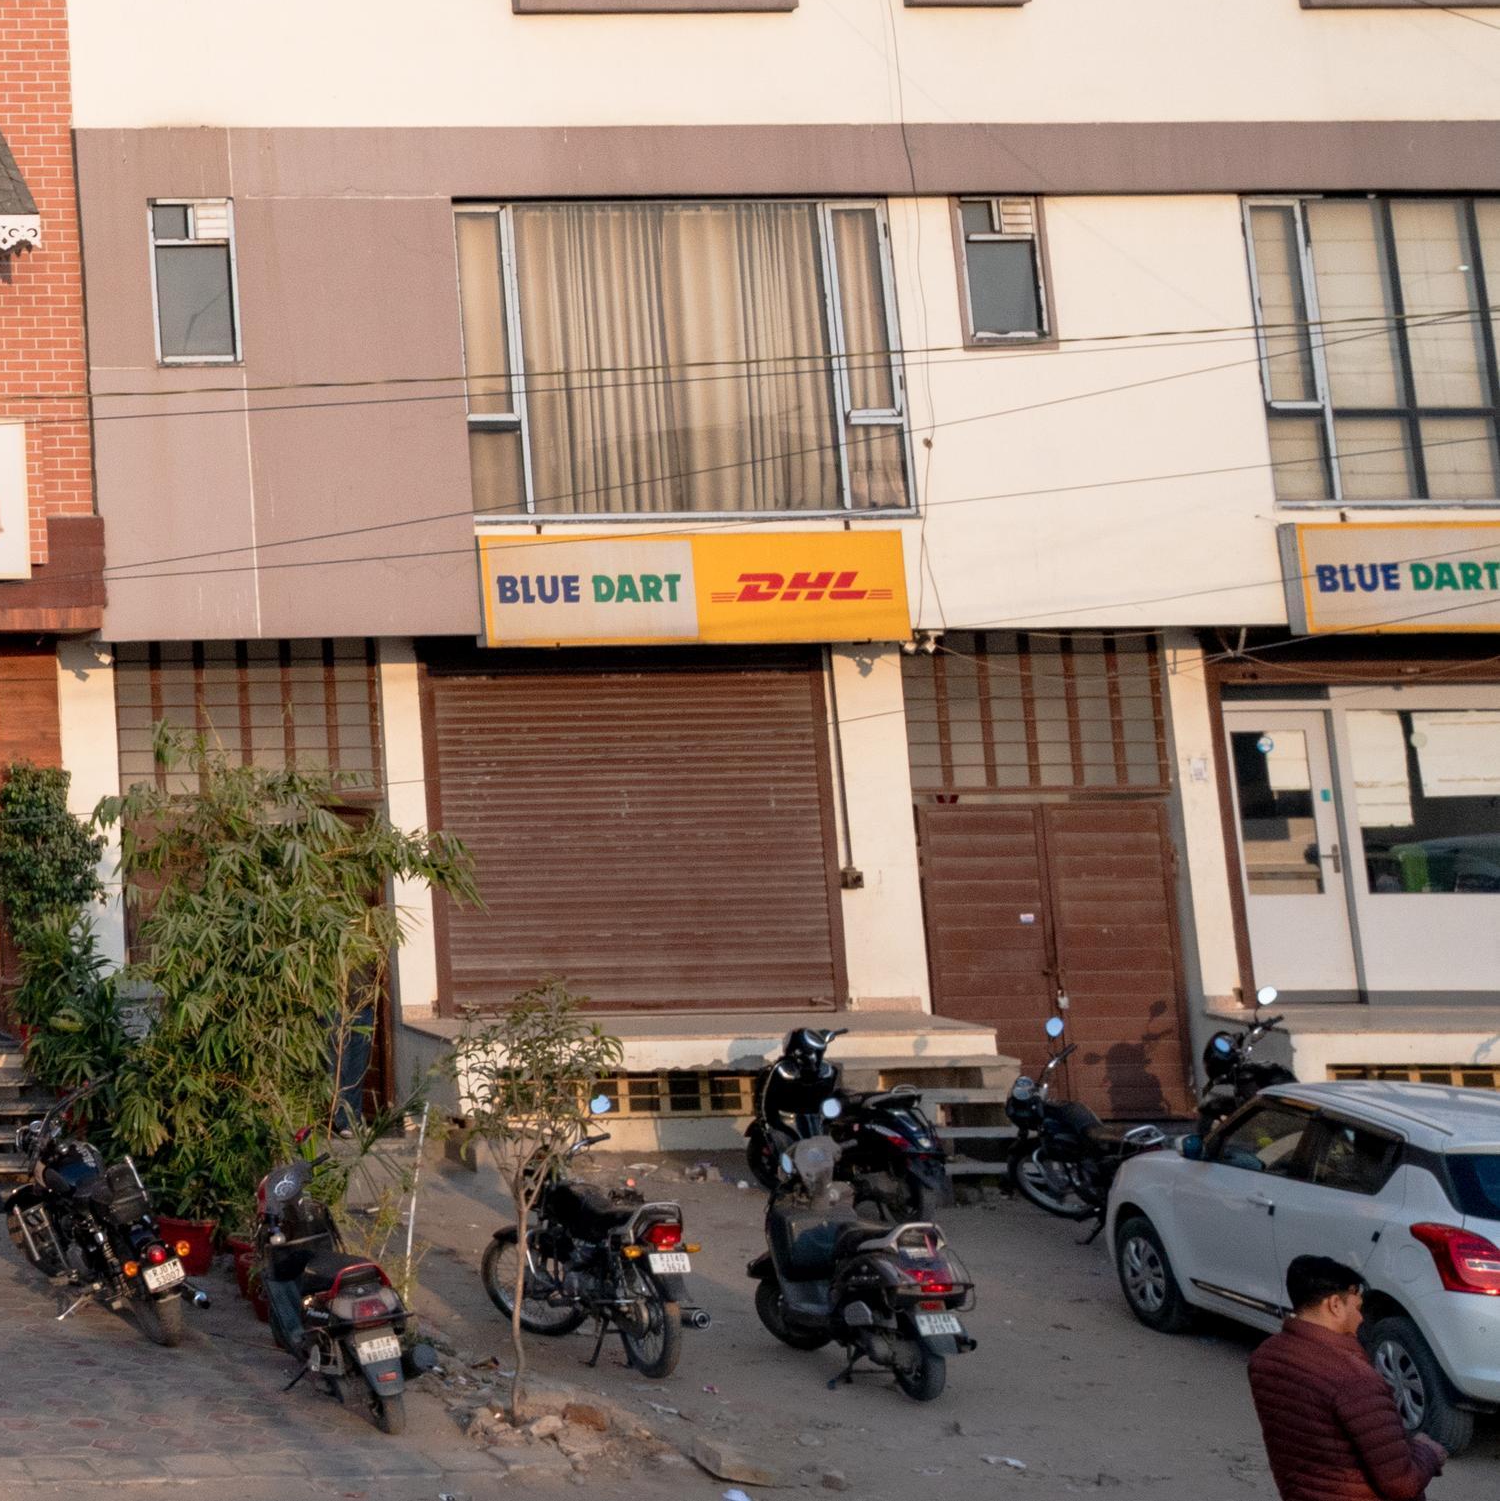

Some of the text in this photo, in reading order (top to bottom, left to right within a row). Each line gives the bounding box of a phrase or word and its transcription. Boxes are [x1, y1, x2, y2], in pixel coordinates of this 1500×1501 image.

[495, 571, 869, 604] BLUE DART DHL
[1315, 560, 1500, 593] BLUE DART
